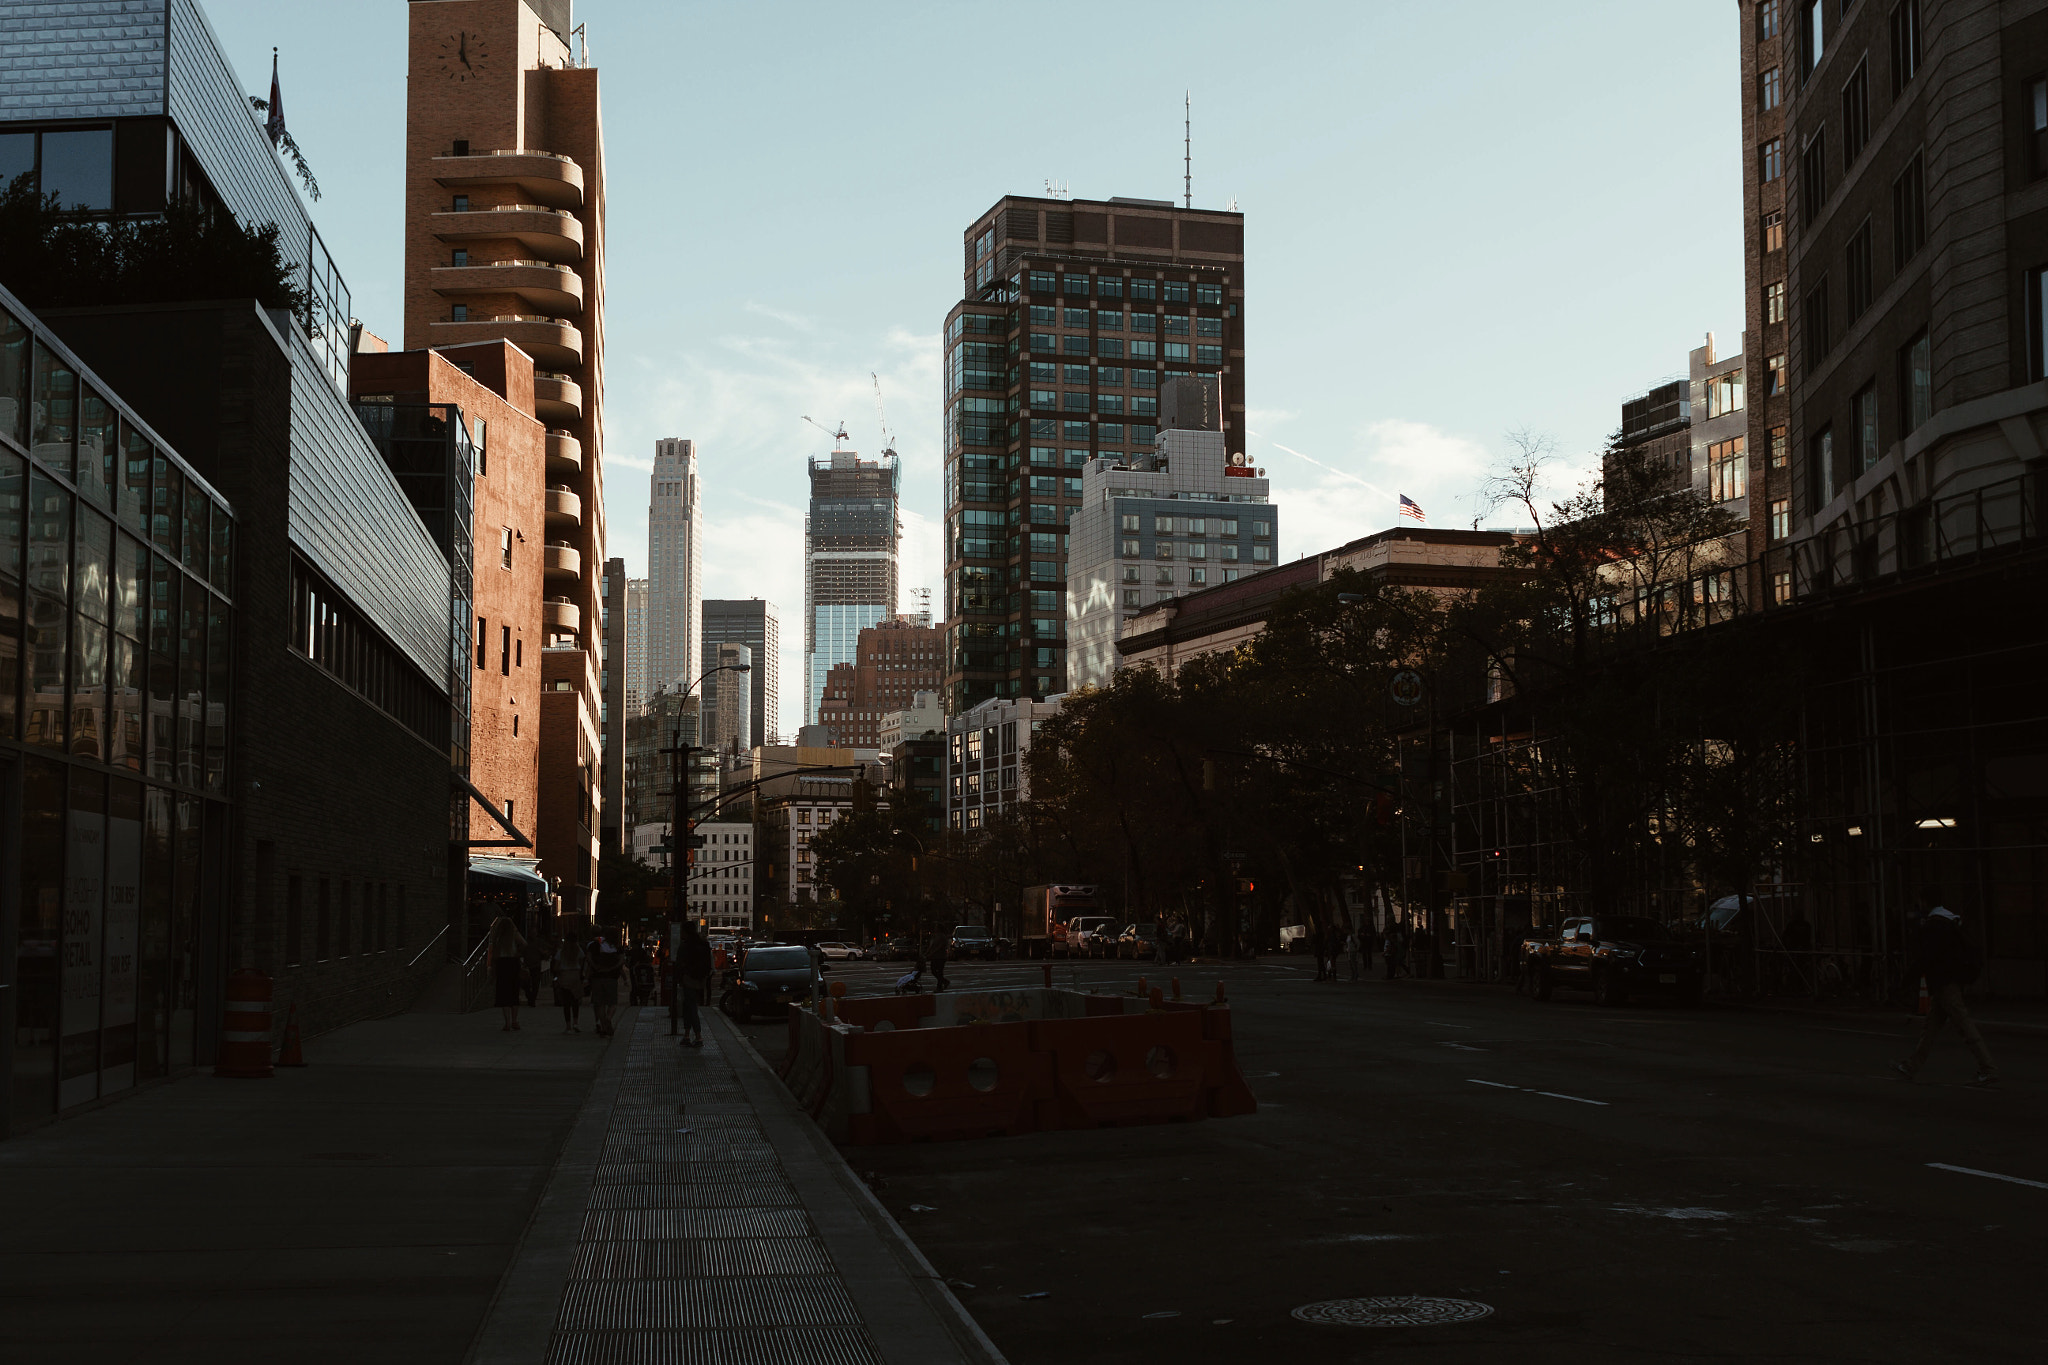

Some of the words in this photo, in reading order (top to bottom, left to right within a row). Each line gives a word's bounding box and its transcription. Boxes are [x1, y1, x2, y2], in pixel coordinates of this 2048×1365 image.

[125, 885, 136, 904] RSF
[64, 910, 90, 935] SOHO
[64, 942, 93, 967] RETAIL
[121, 954, 132, 973] RSF
[63, 972, 101, 999] AVAILABLE
